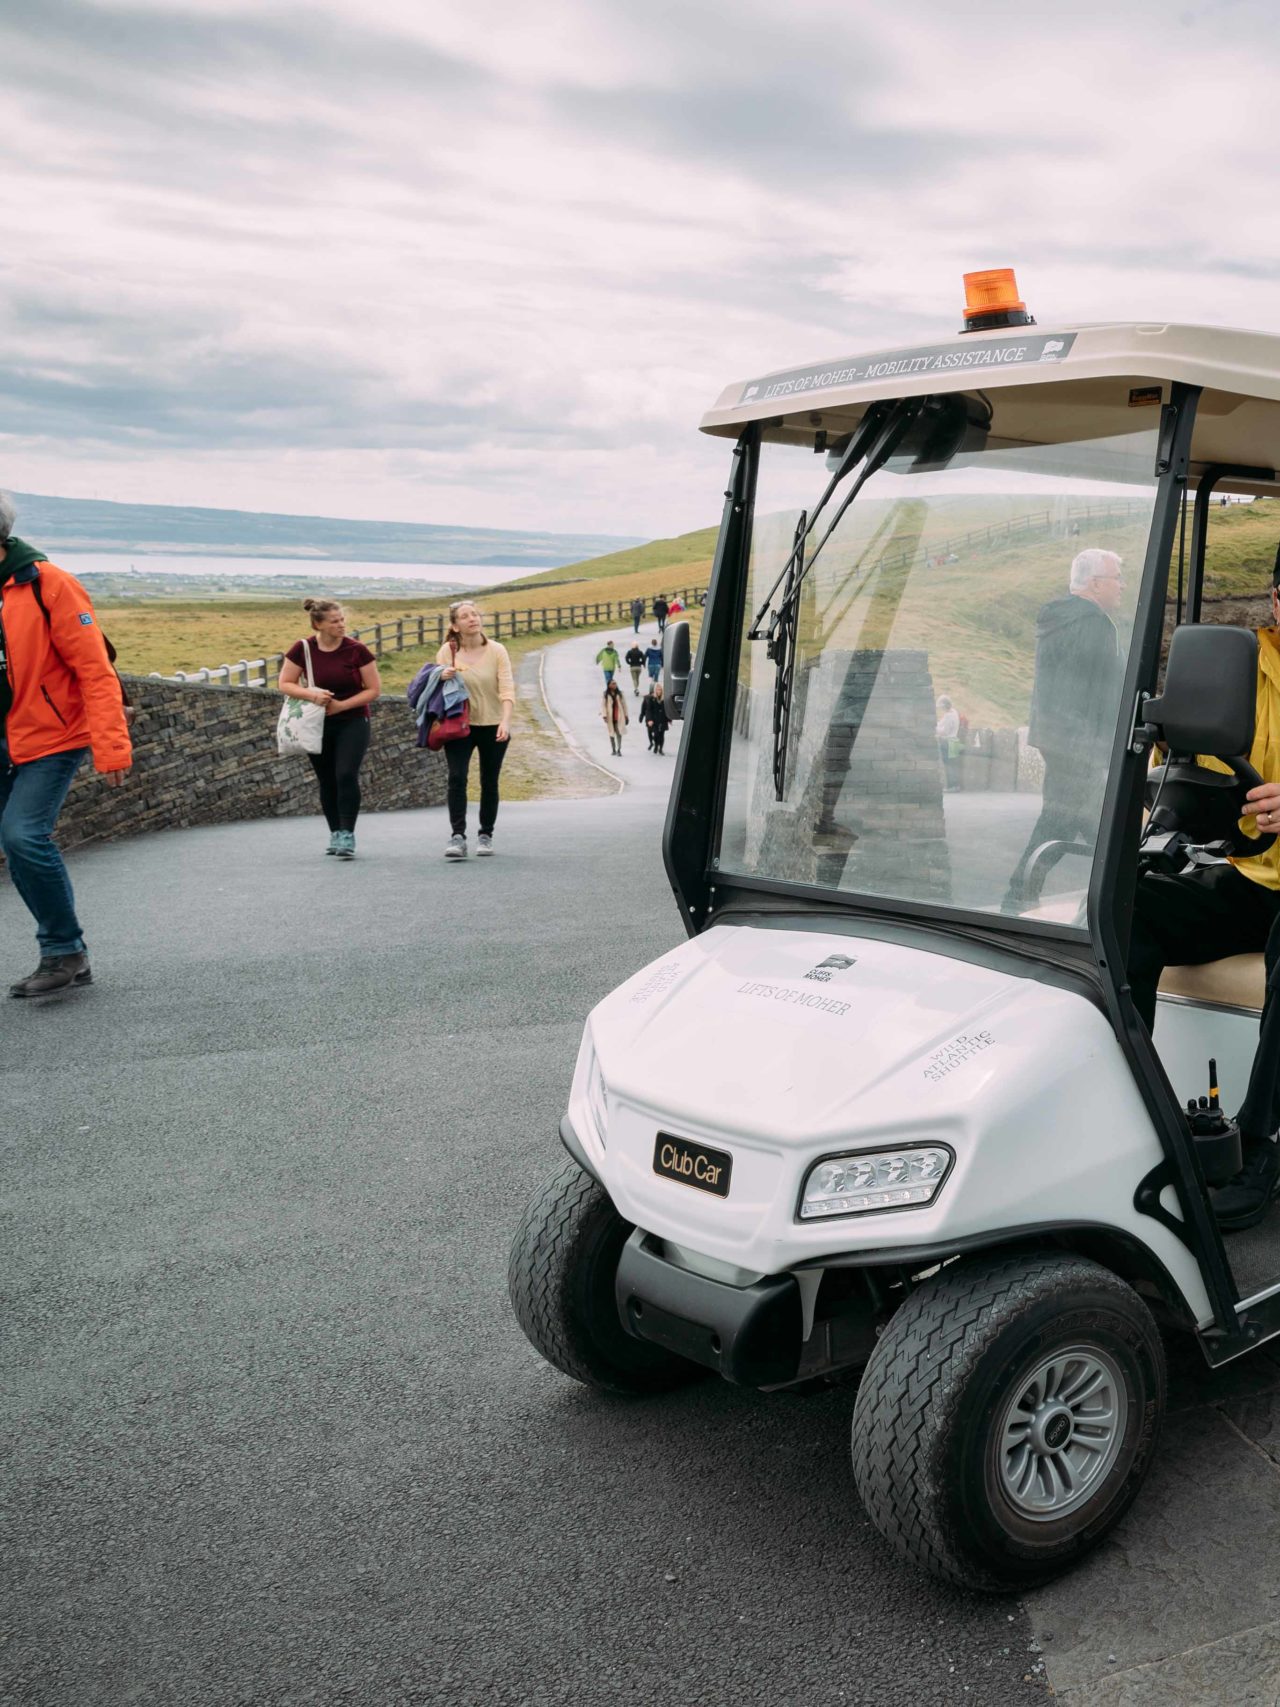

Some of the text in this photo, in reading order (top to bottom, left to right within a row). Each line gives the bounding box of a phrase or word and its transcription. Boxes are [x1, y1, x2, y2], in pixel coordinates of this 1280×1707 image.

[764, 381, 794, 398] LIFTS
[794, 378, 812, 391] OF
[811, 369, 856, 386] MOHER
[864, 356, 935, 378] MOBILITY
[932, 347, 1026, 368] ASSISTANCE
[802, 973, 831, 982] MOHER
[737, 982, 851, 1015] LIFTS OF MOHER
[923, 1030, 991, 1078] ATLANTIC
[930, 1035, 968, 1061] WILD
[931, 1037, 996, 1082] SHUTTLE
[661, 1144, 722, 1185] Club Car
